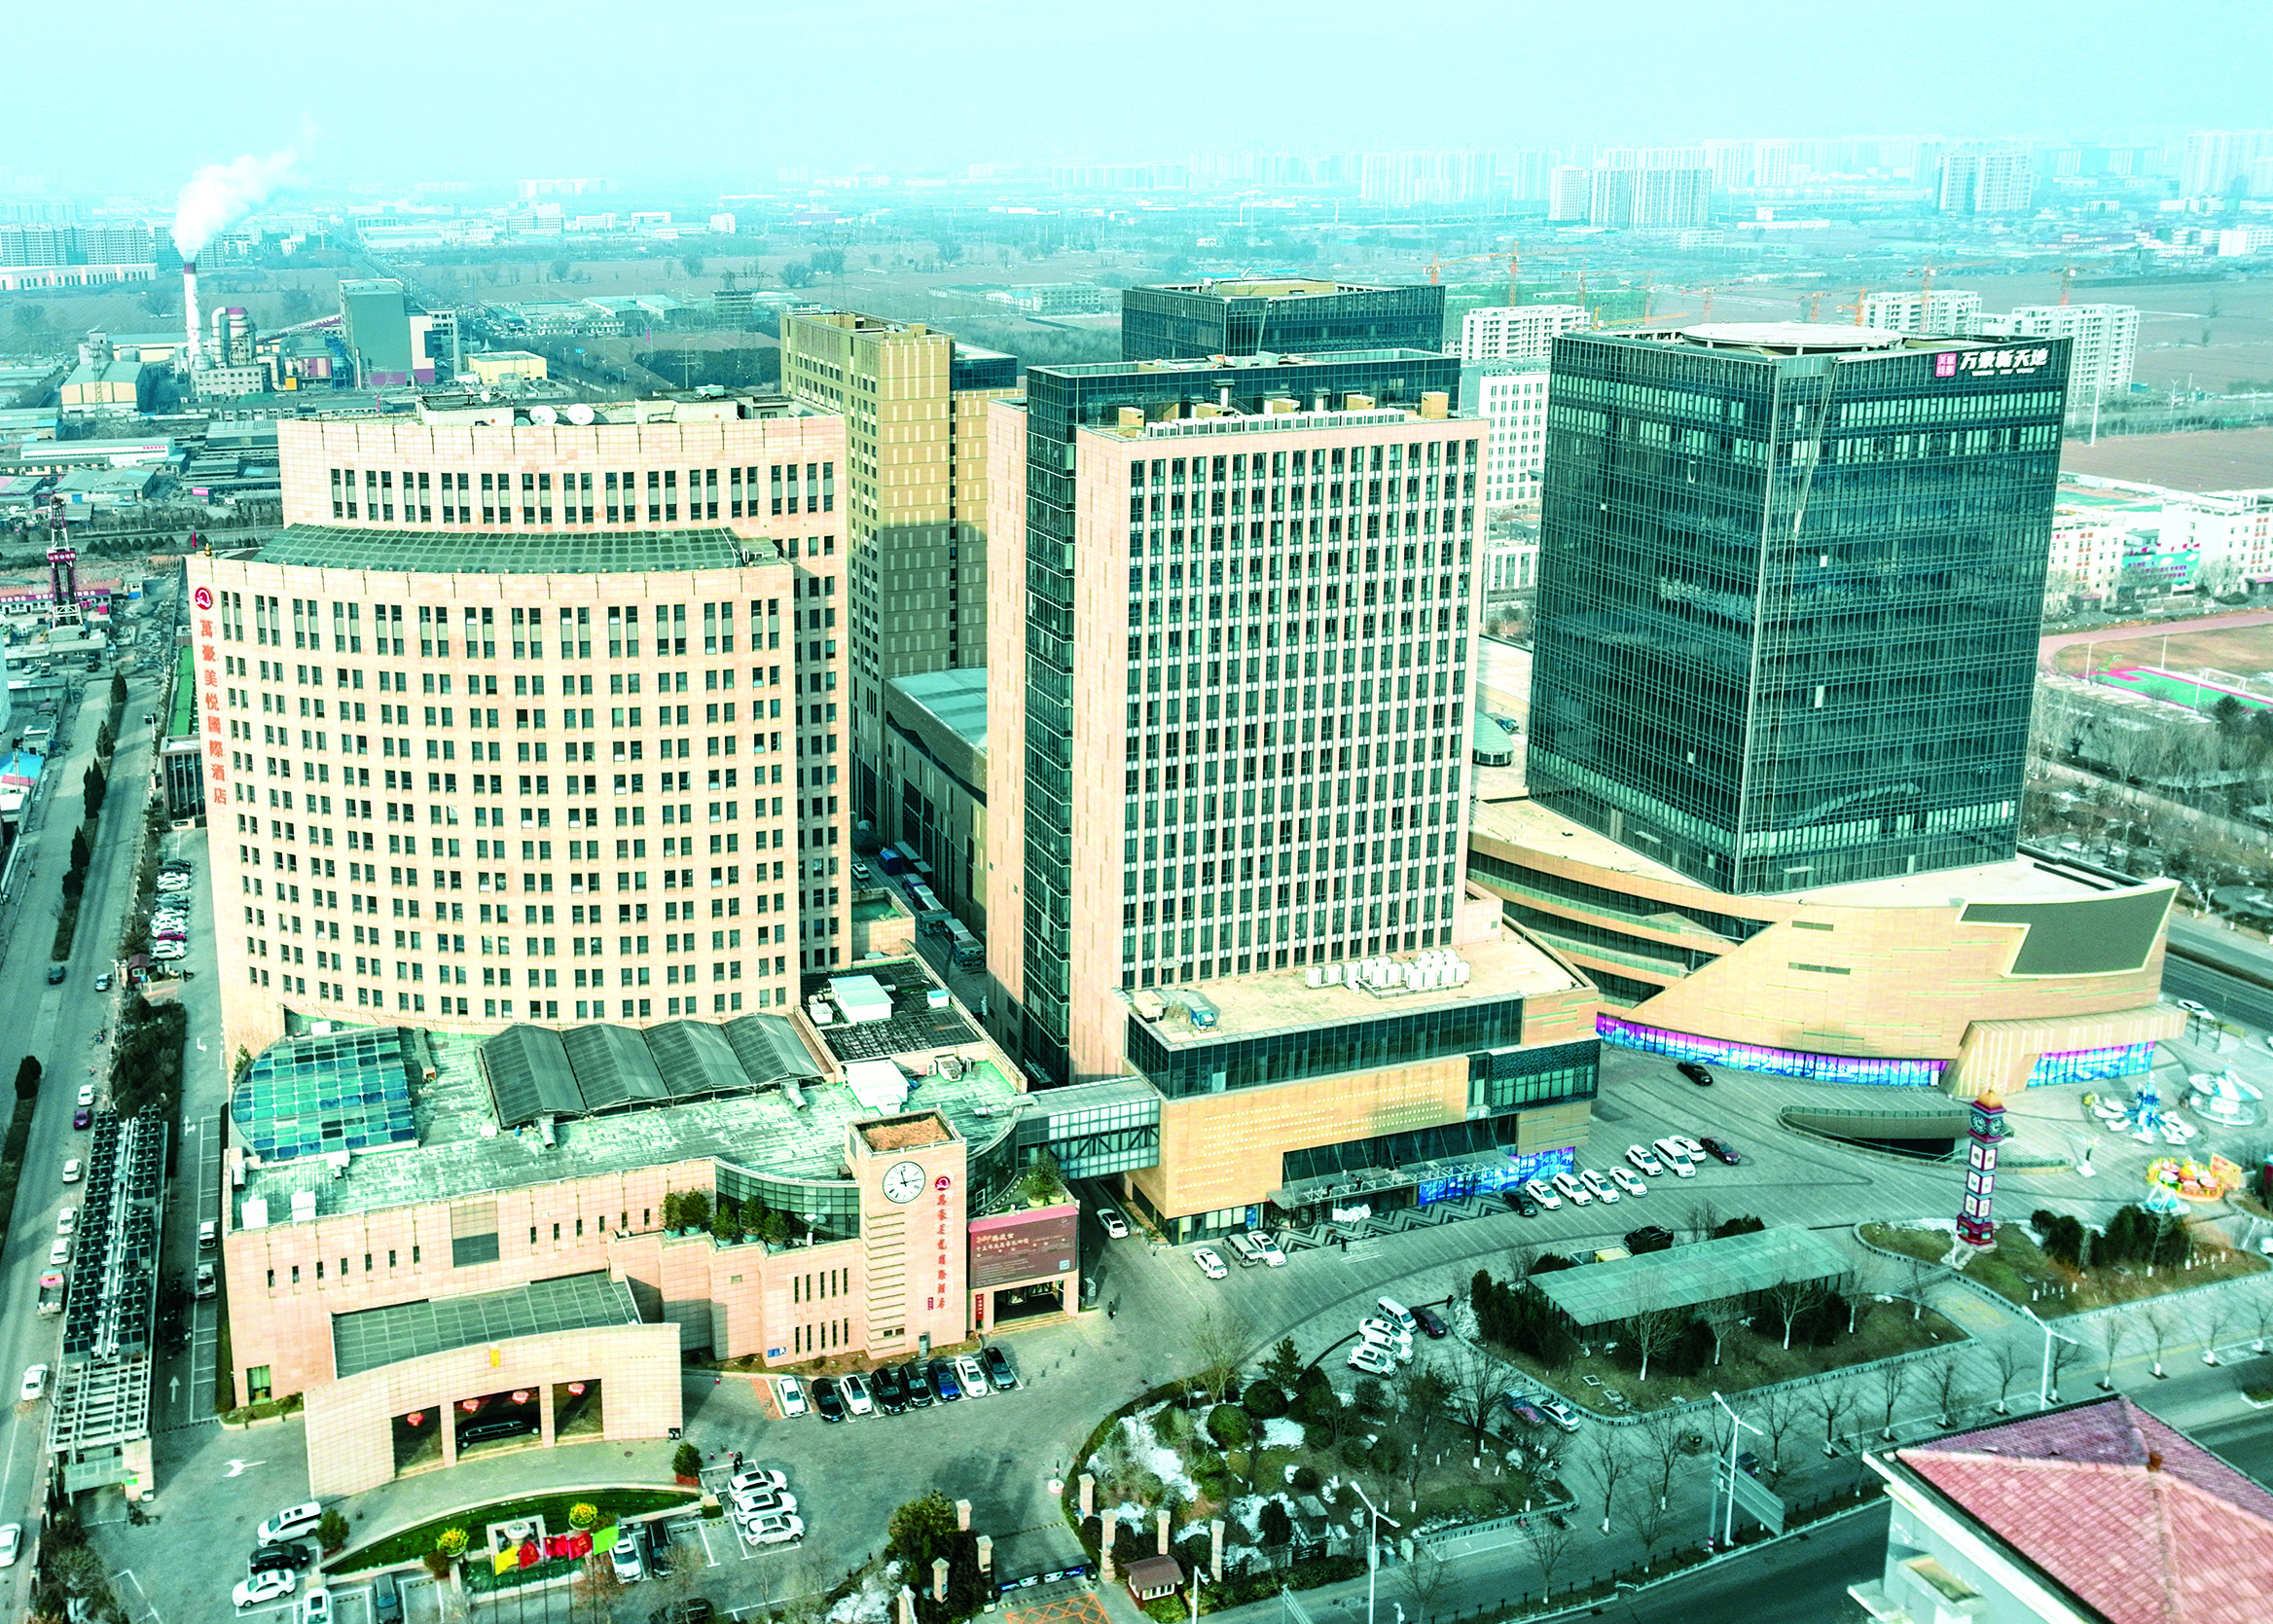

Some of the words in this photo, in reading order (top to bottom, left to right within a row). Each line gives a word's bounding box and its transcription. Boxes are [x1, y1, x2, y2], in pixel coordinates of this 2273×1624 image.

[1960, 348, 2048, 370] 万豪新天地
